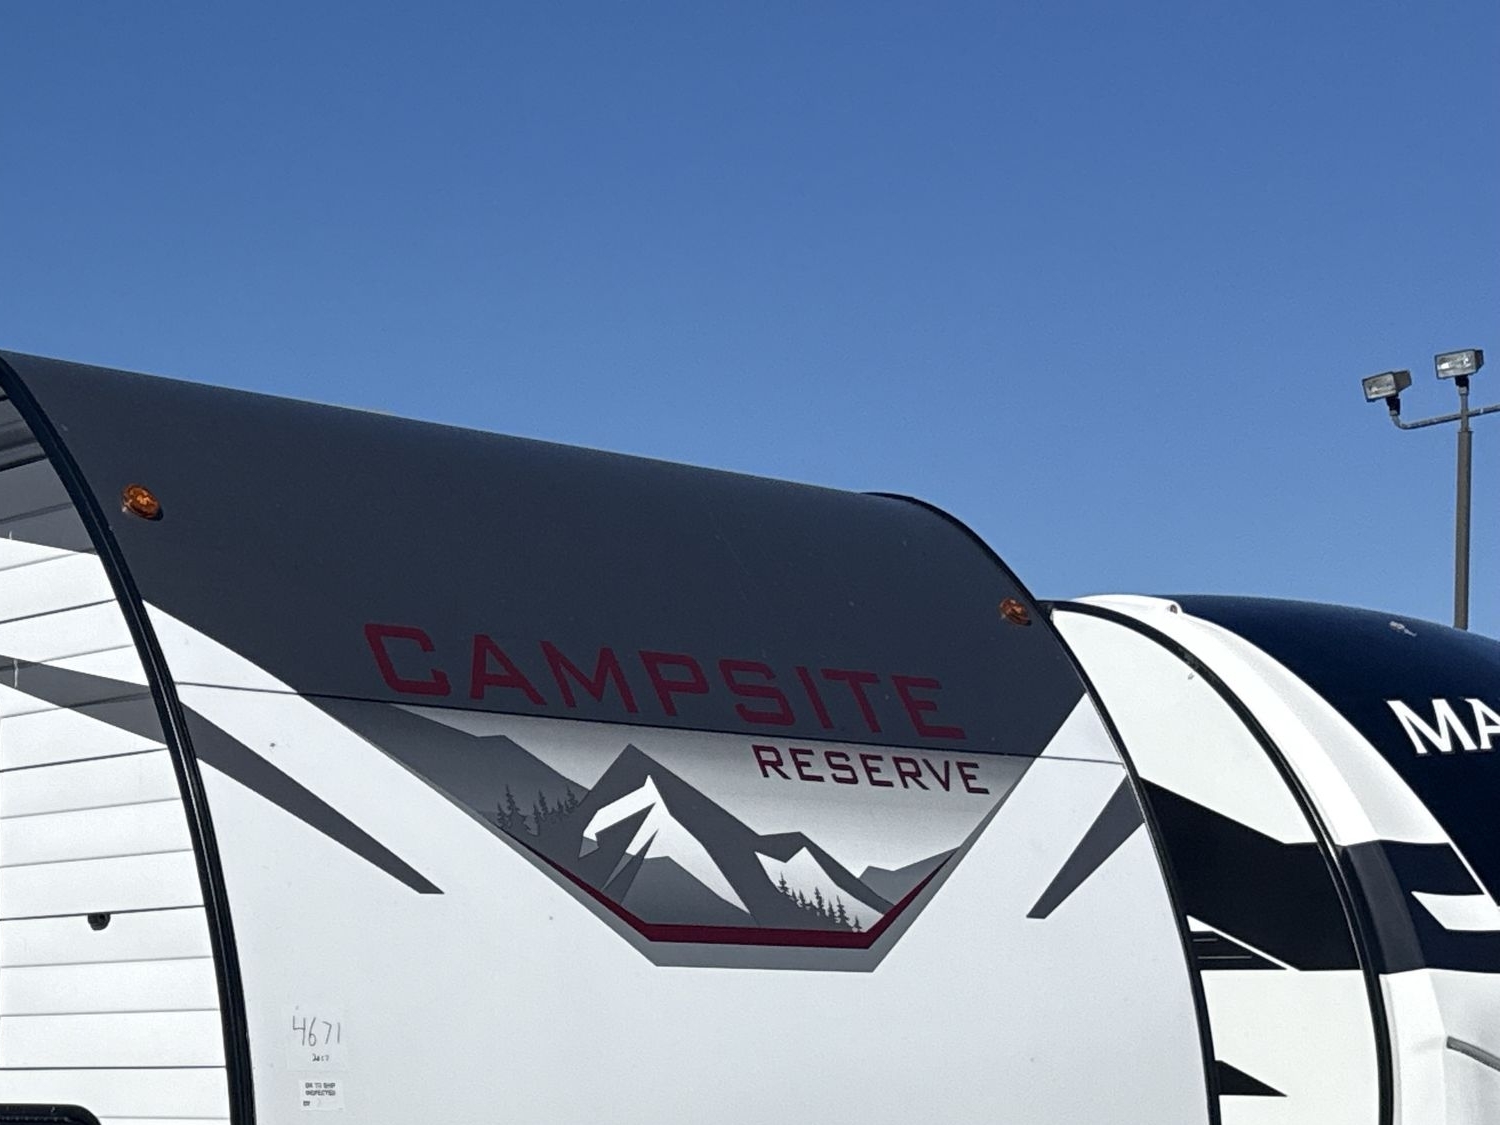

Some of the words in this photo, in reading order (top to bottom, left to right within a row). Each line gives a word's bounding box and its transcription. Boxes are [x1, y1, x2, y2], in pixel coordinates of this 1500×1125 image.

[363, 622, 967, 742] CAMPSITE
[1384, 698, 1500, 754] MA
[752, 744, 991, 796] RESERVE
[292, 1015, 341, 1046] 4671
